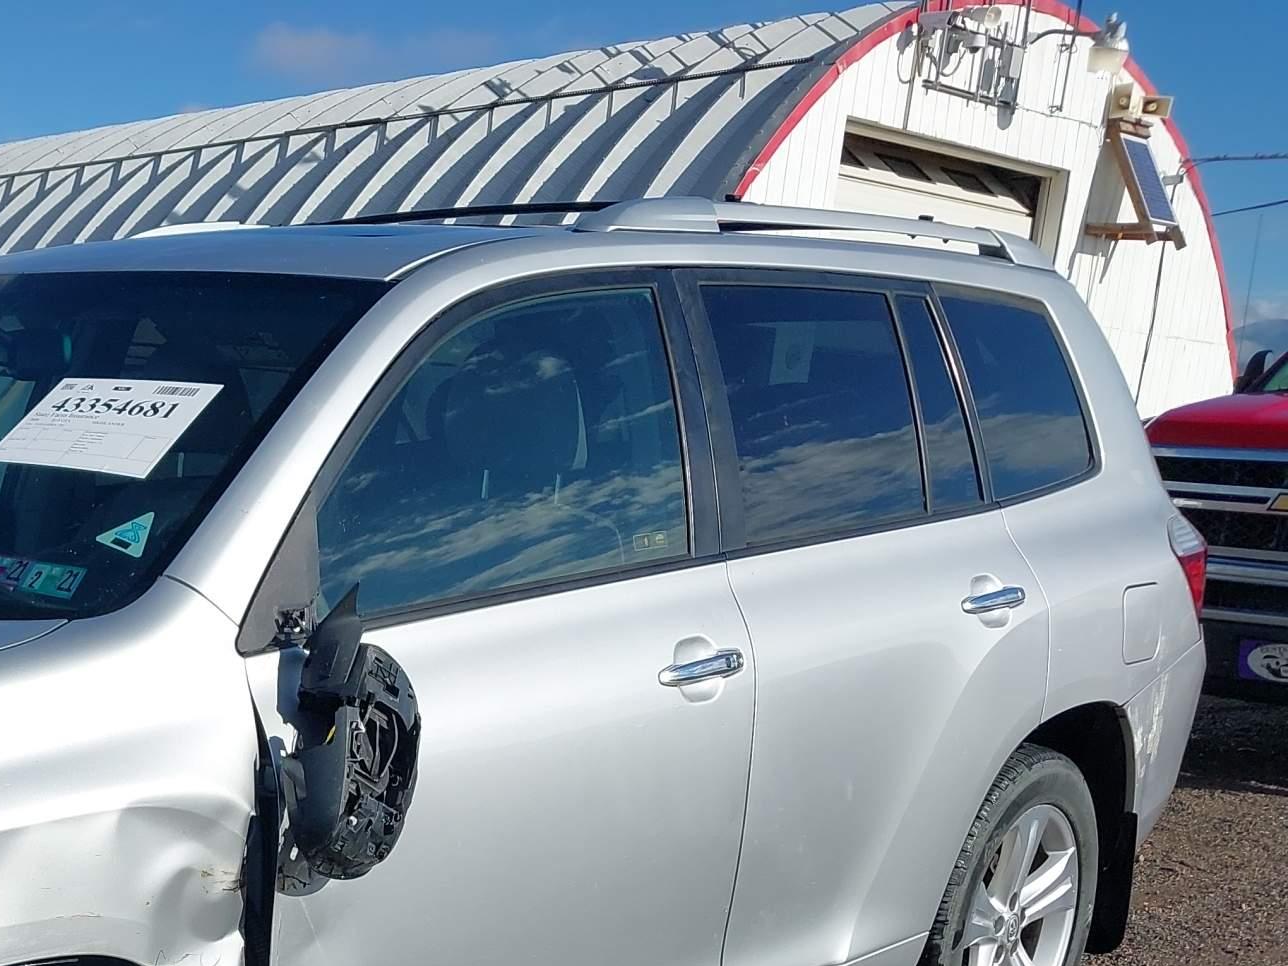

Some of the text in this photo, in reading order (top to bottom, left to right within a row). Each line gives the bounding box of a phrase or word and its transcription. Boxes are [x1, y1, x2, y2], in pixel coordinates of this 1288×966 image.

[51, 397, 180, 420] 43354681
[7, 559, 30, 582] 21
[56, 569, 80, 593] 21
